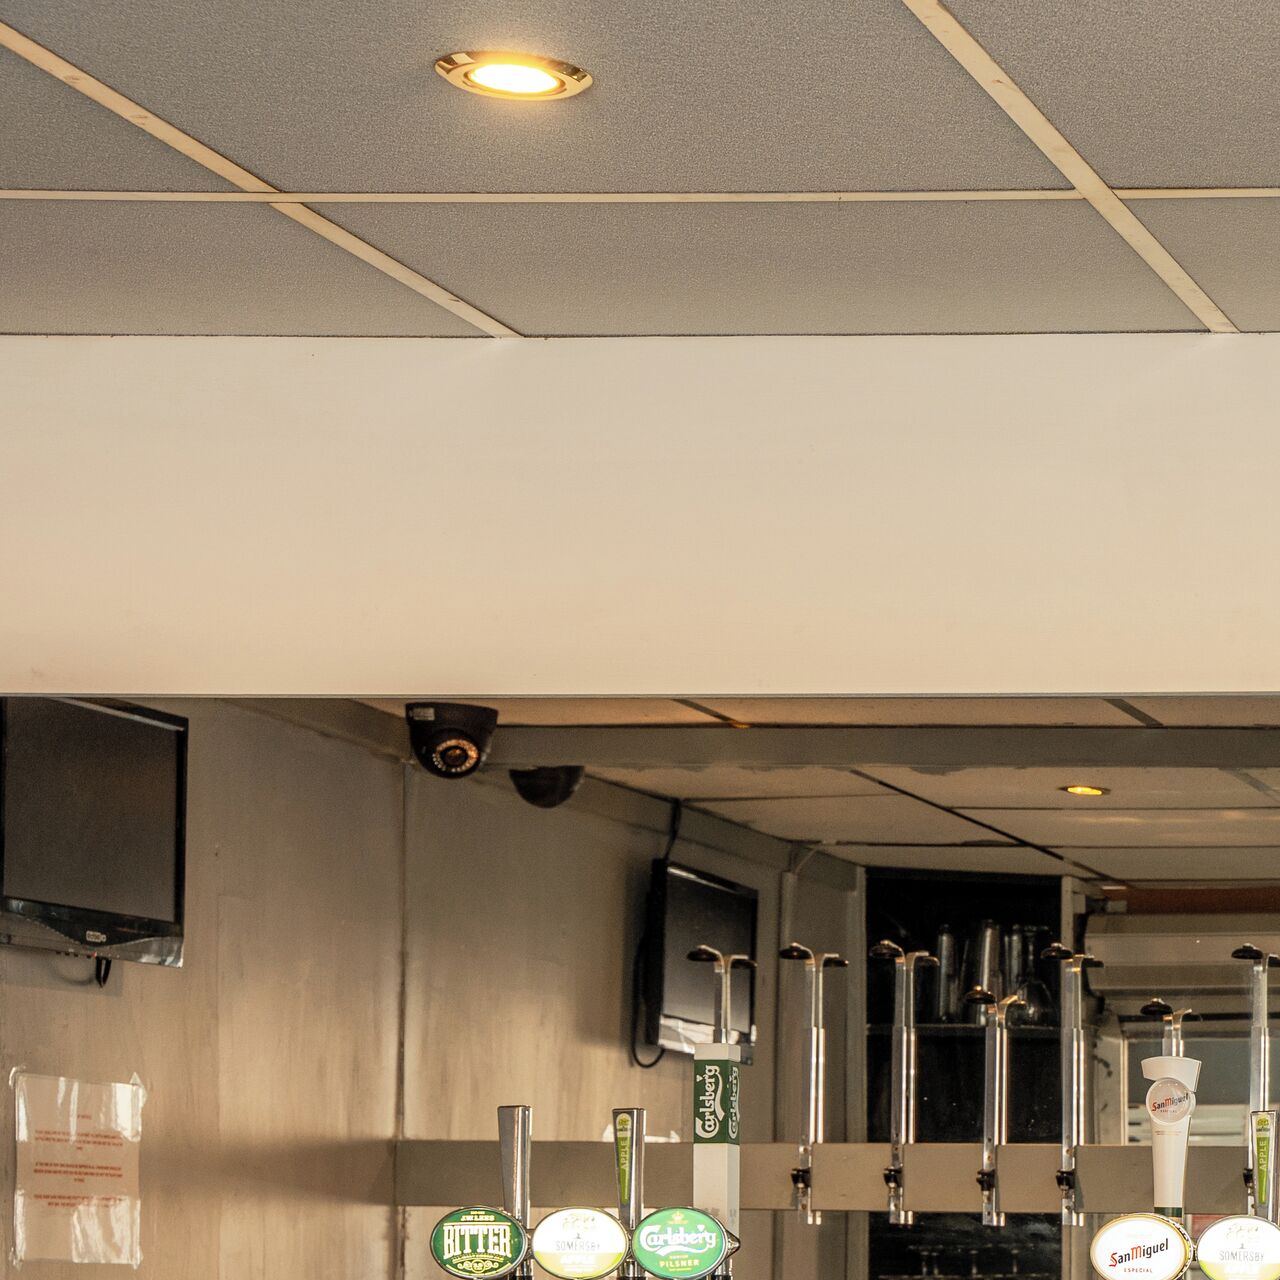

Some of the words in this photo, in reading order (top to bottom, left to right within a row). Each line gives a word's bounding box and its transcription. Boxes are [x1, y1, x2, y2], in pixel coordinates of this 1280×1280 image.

[696, 1065, 720, 1138] Carlsberg
[1258, 1140, 1266, 1171] APPLE
[443, 1225, 512, 1259] BITTER
[555, 1241, 600, 1251] SOMERSBY
[639, 1224, 716, 1251] Carlsberg
[659, 1259, 699, 1267] PILSNER
[1219, 1252, 1264, 1262] SOMERSBY
